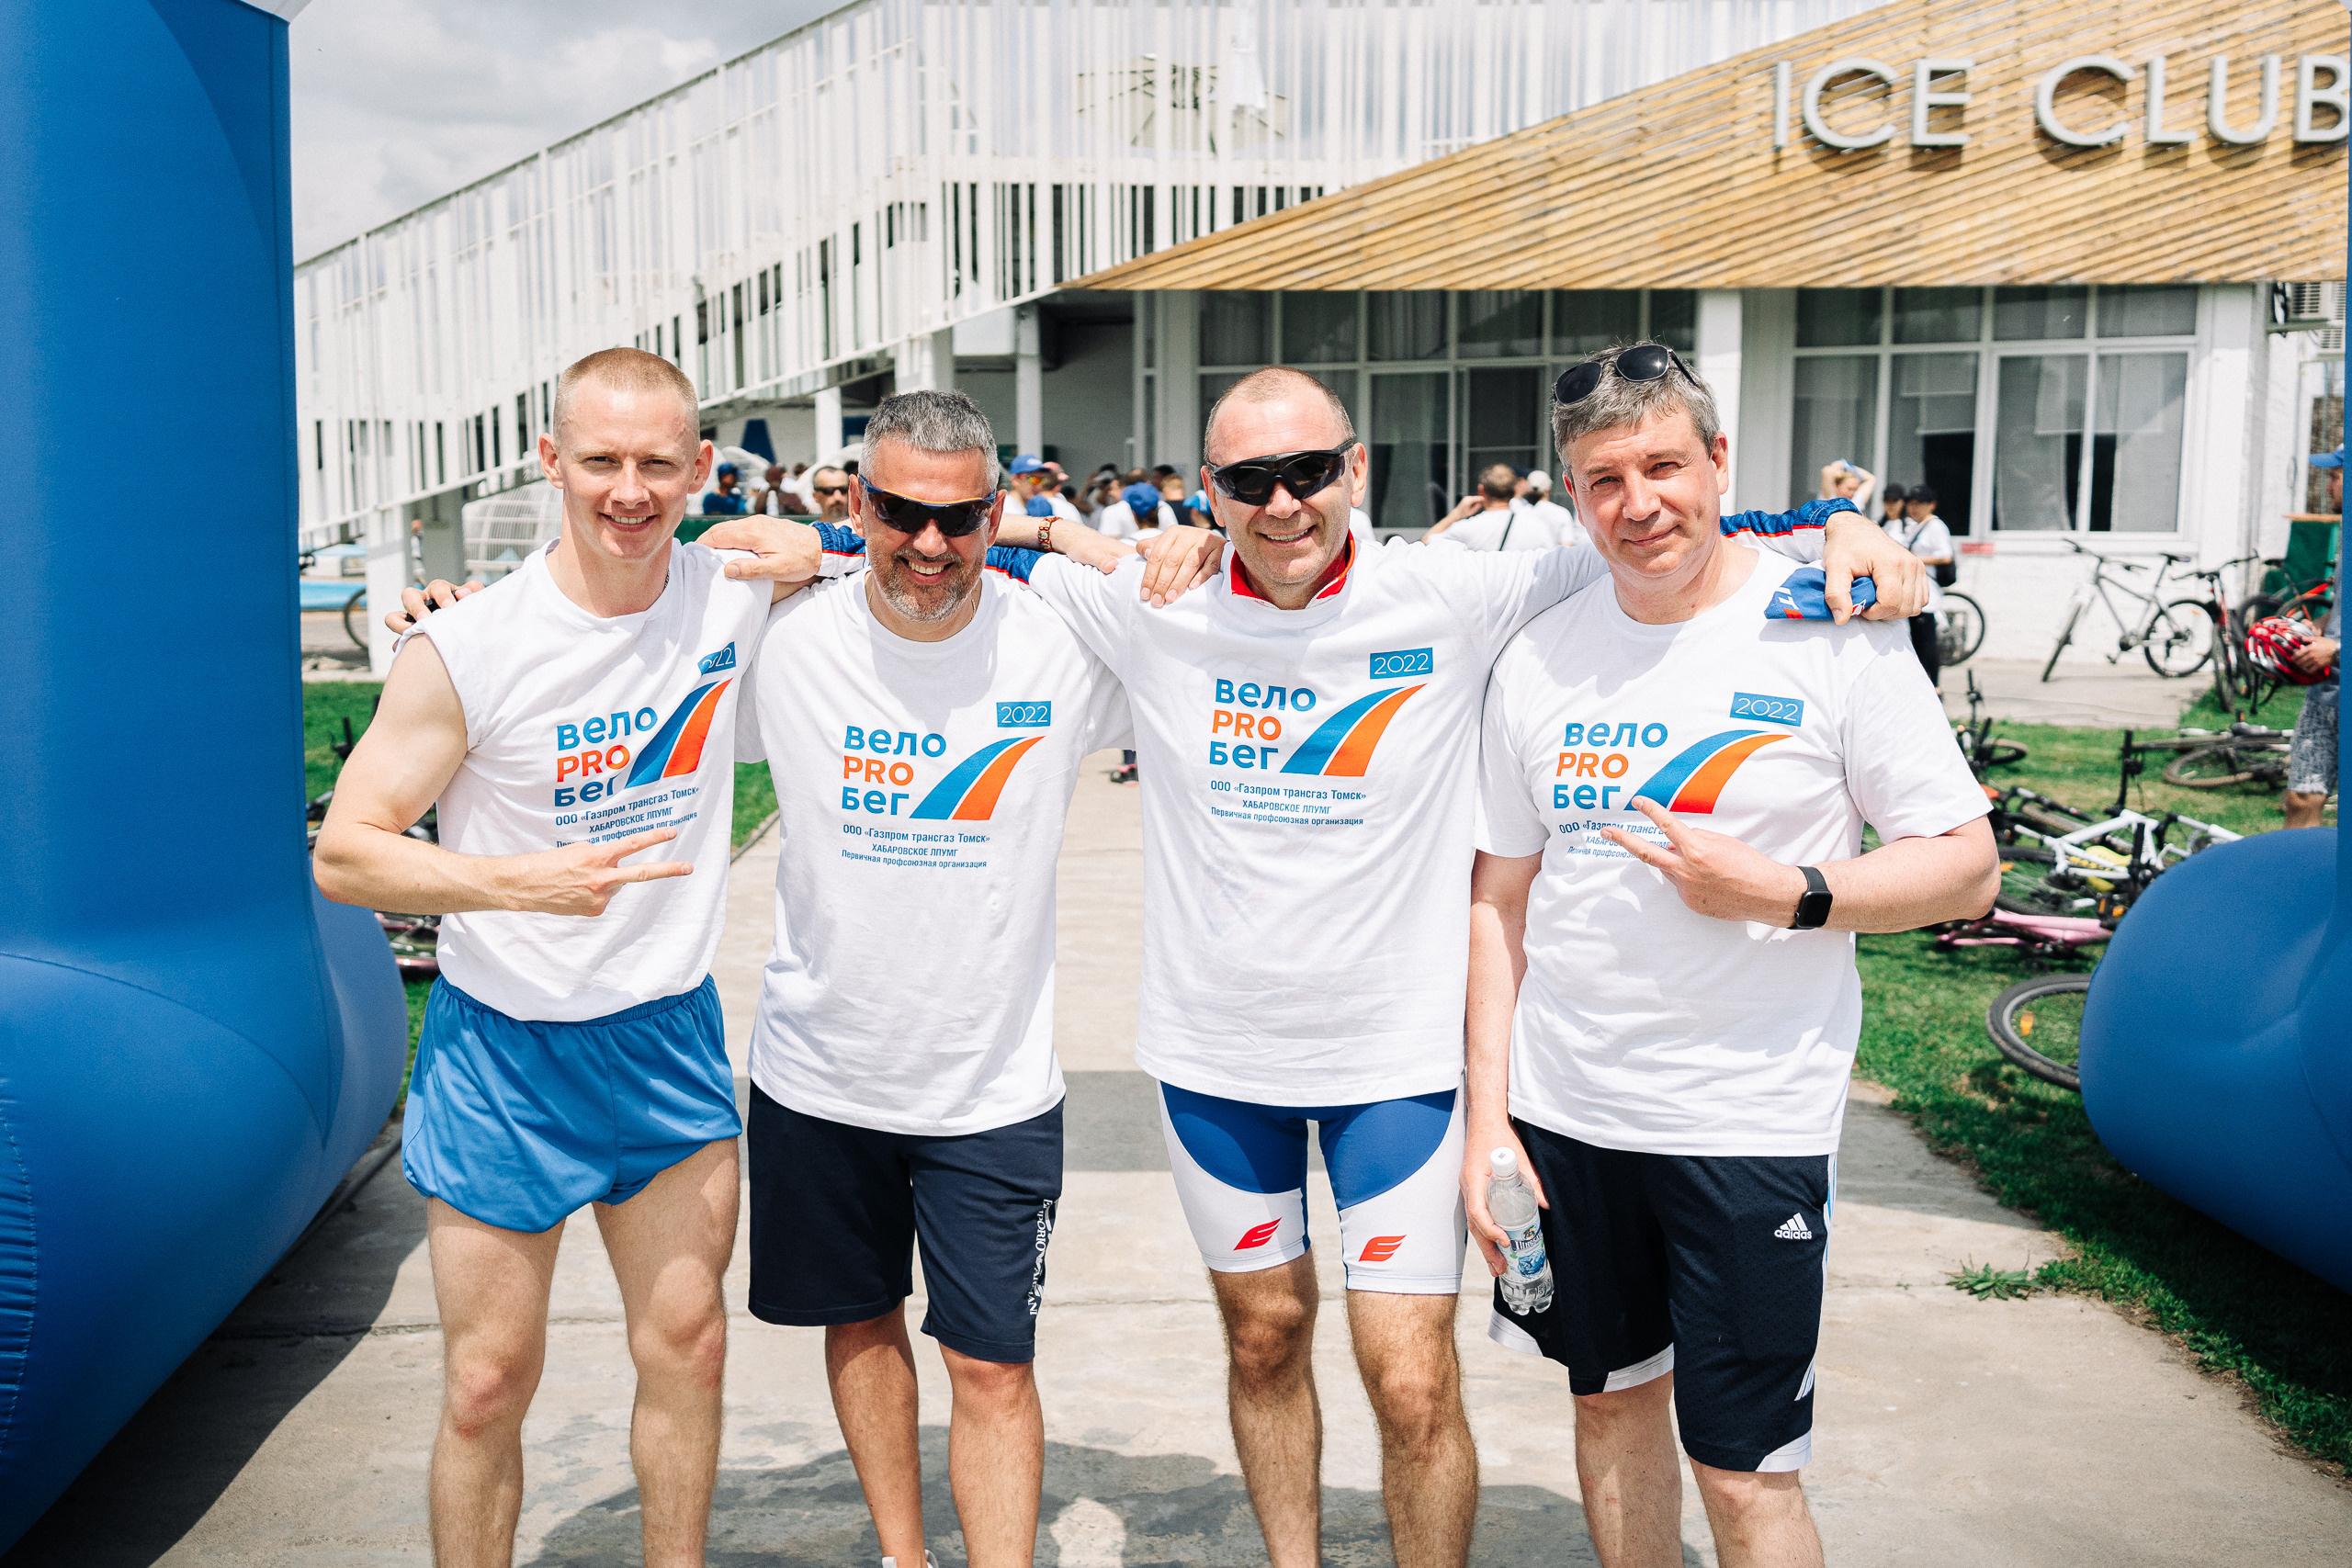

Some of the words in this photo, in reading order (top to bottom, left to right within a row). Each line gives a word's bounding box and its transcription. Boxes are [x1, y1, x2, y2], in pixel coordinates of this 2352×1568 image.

[1774, 57, 1975, 149] ICE
[2035, 54, 2350, 146] CLUB
[1374, 652, 1430, 675] 2022
[1001, 705, 1048, 724] 2022
[1735, 697, 1798, 722] 2022
[1212, 709, 1282, 741] PRO
[557, 744, 630, 783] PRO
[843, 755, 914, 786] PRO
[1555, 752, 1629, 779] PRO
[1210, 780, 1231, 792] ООО
[1234, 783, 1280, 797] «Газпром
[1283, 787, 1328, 800] трансгаз
[1331, 789, 1366, 800] Томск»
[556, 814, 578, 826] ООО
[581, 805, 626, 822] «Газпром
[628, 793, 668, 811] трансгаз
[671, 786, 699, 800] Томск»
[1211, 807, 1251, 820] Первичная
[1253, 813, 1309, 825] профсоюзная
[1311, 818, 1363, 826] организация
[1242, 799, 1300, 813] ХАБАРОВСКОЕ
[1302, 805, 1332, 815] ЛПУМГ
[589, 815, 645, 833] ХАБАРОВСКОЕ
[647, 807, 673, 820] ЛПУМГ
[1559, 821, 1580, 834] ООО
[842, 824, 862, 836] ООО
[865, 828, 909, 841] «Газпром
[911, 831, 955, 844] трансгаз
[958, 833, 990, 843] Томск»
[842, 850, 881, 863] Первичная
[883, 856, 937, 868] профсоюзная
[938, 860, 987, 869] организация
[872, 843, 928, 856] ХАБАРОВСКОЕ
[930, 848, 958, 857] ЛПУМГ
[1774, 1229, 1813, 1240] adidas
